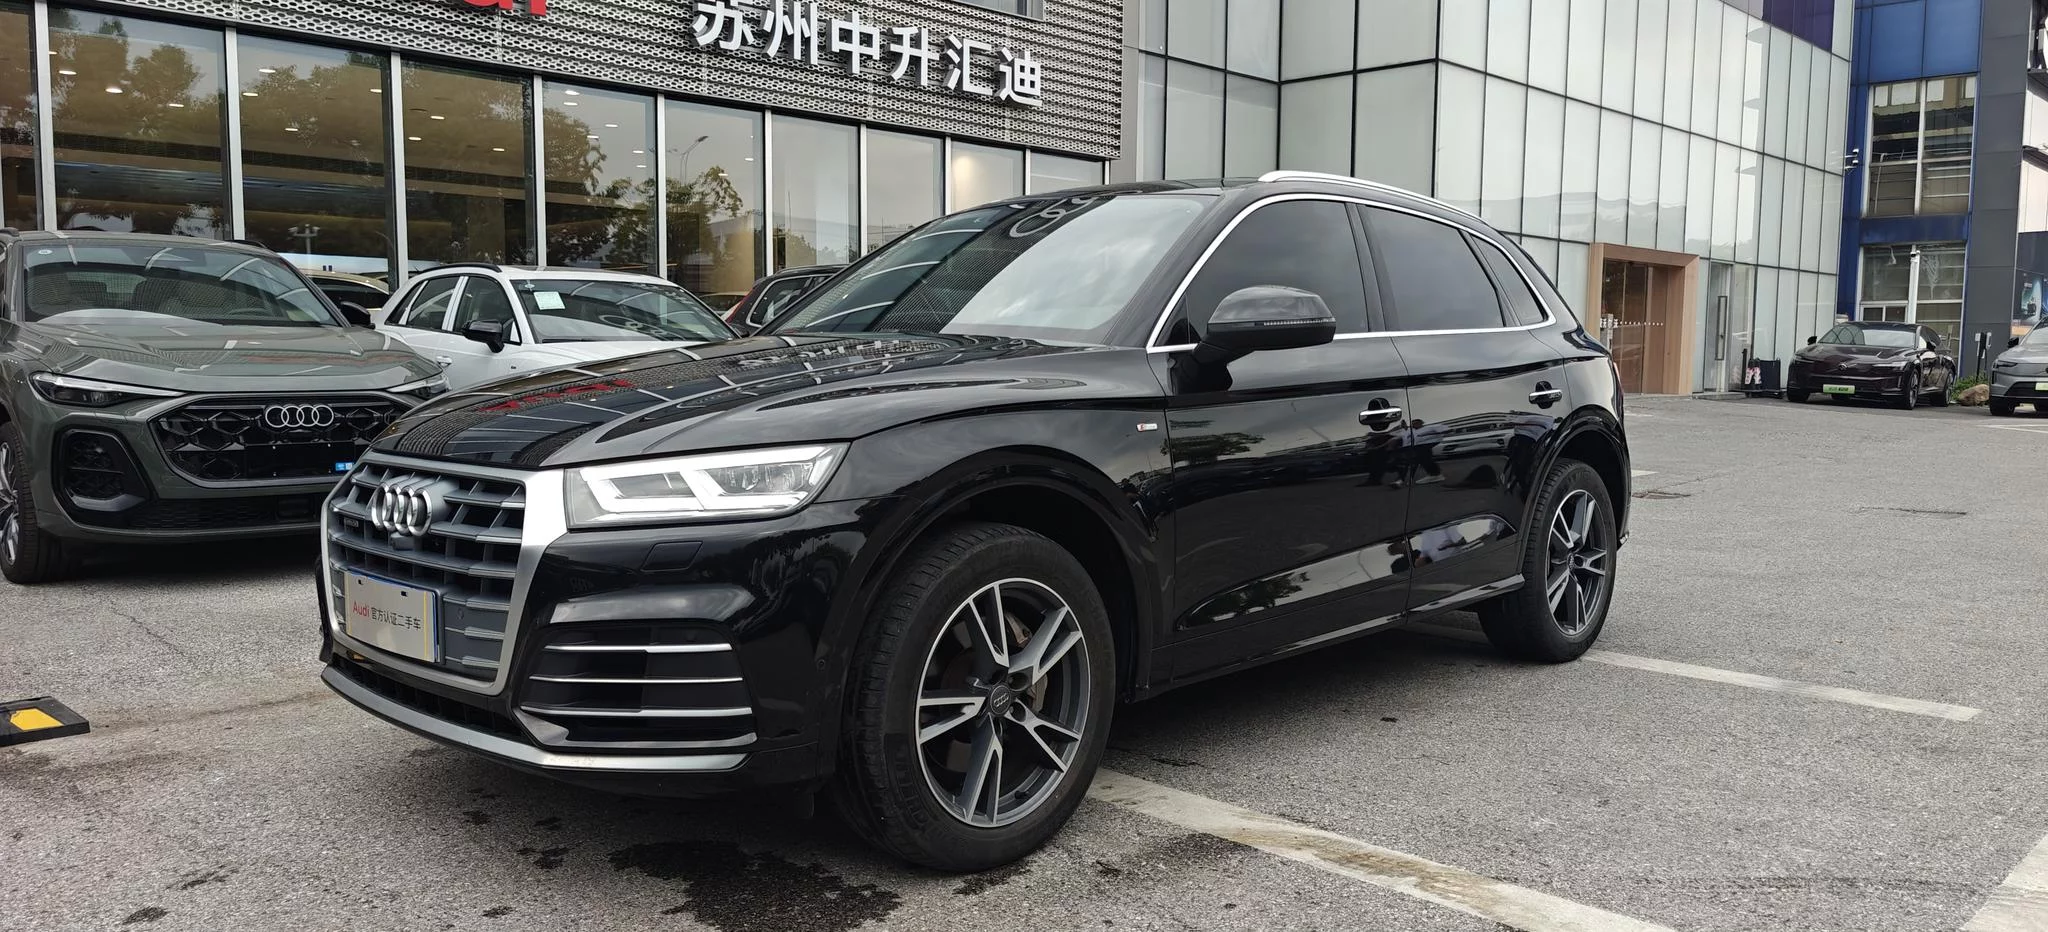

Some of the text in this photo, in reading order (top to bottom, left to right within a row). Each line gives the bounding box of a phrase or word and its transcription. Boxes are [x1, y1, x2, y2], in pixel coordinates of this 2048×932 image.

[692, 0, 1043, 106] 苏州中升汇迪
[353, 602, 421, 631] Audi 官方认证二手车
